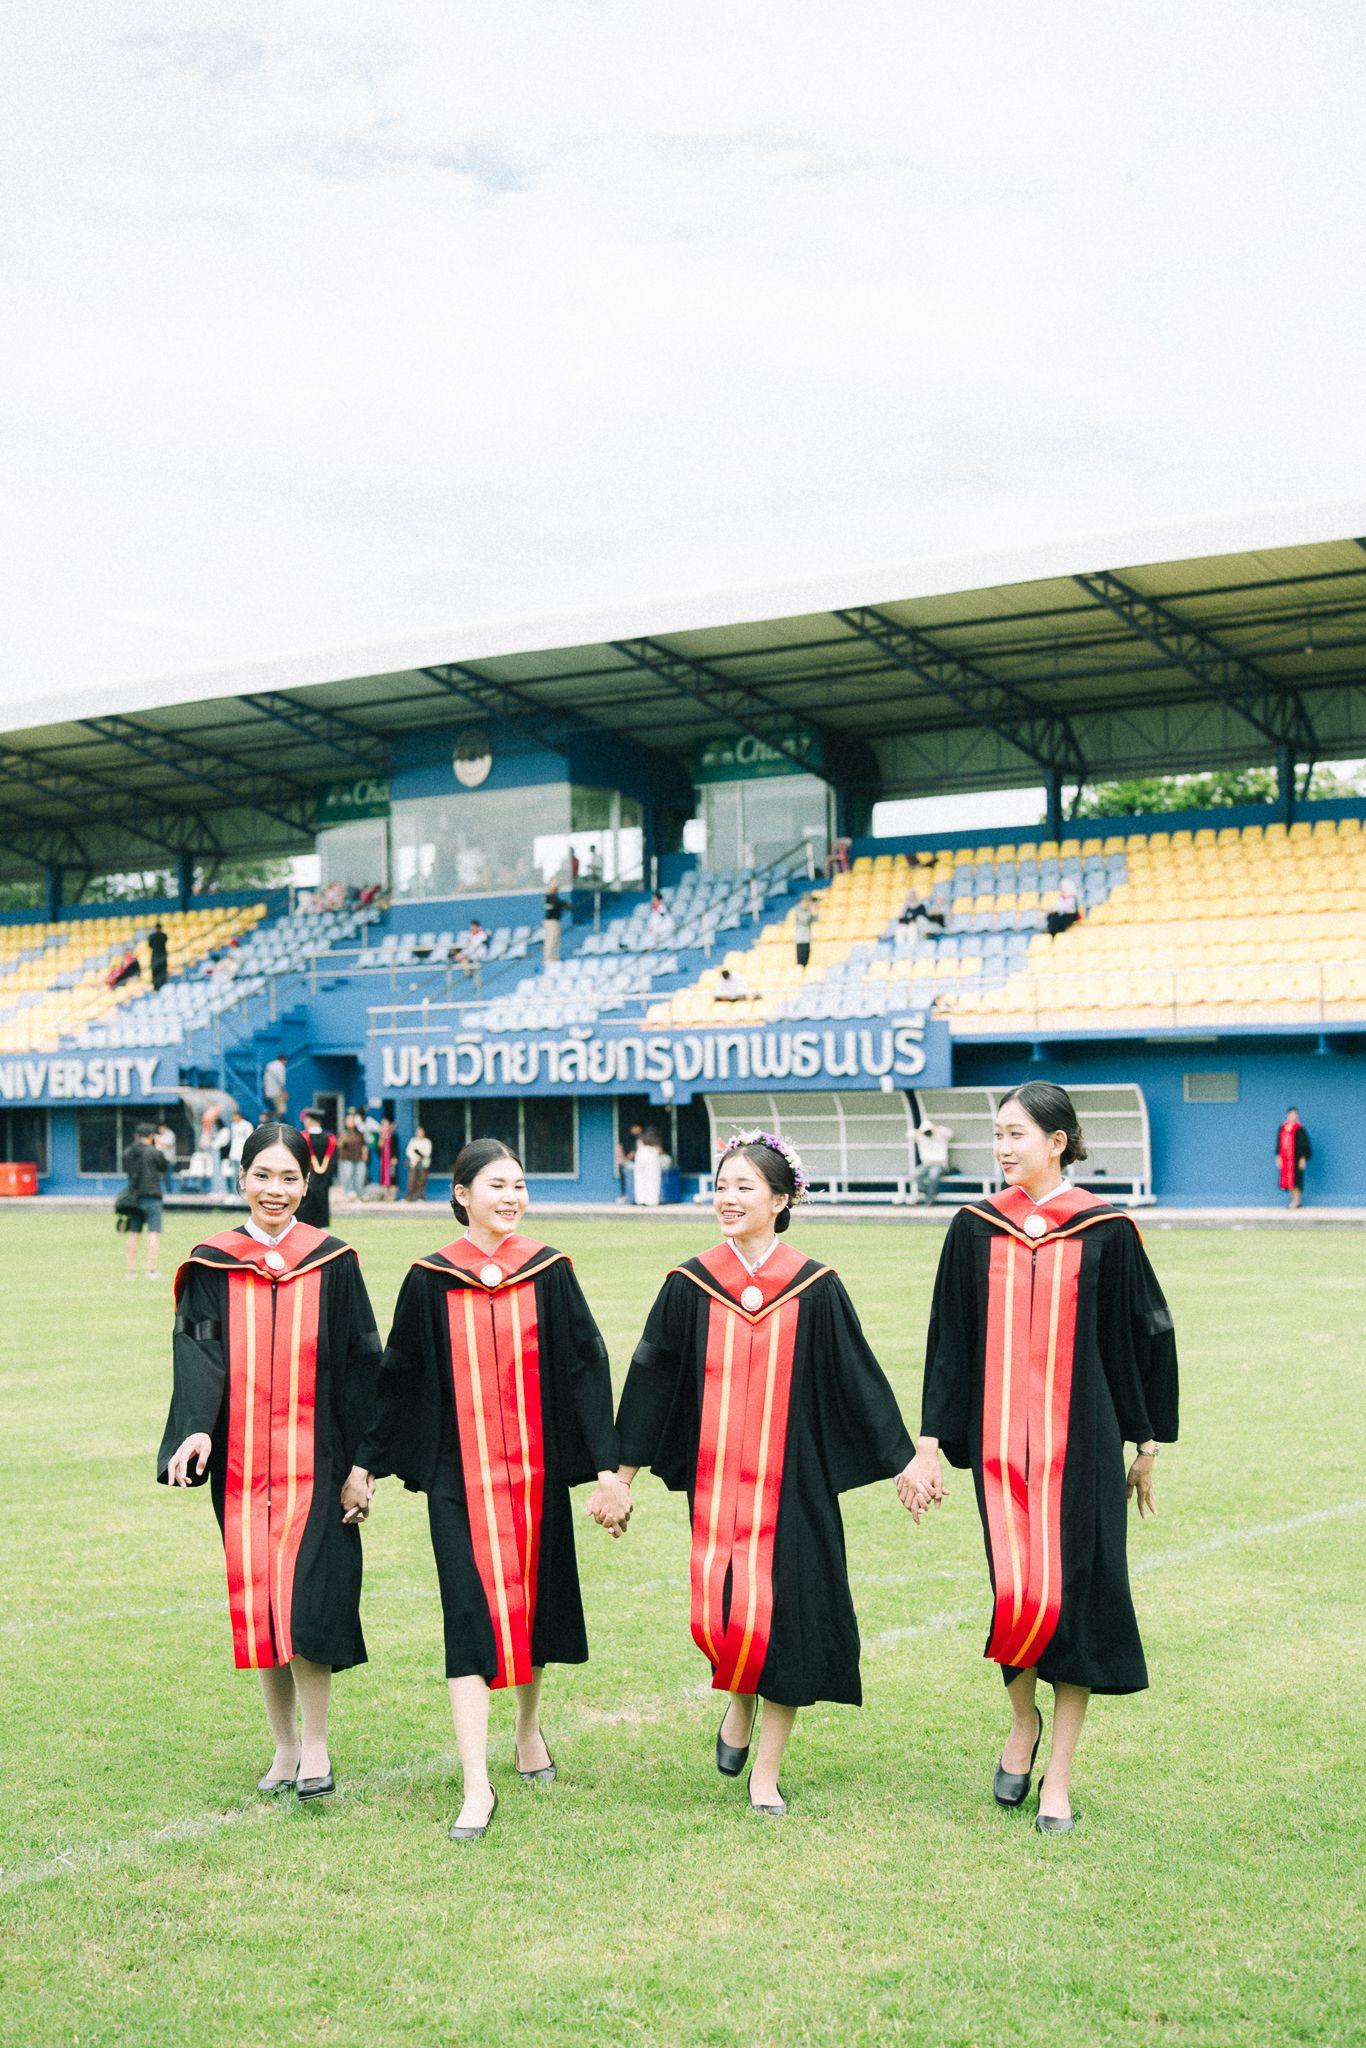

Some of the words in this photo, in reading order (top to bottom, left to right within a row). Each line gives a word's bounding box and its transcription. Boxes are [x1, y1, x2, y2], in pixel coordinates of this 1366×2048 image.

[381, 1012, 927, 1096] มหาวิทยาลัยกรุงเทพธนบุรี
